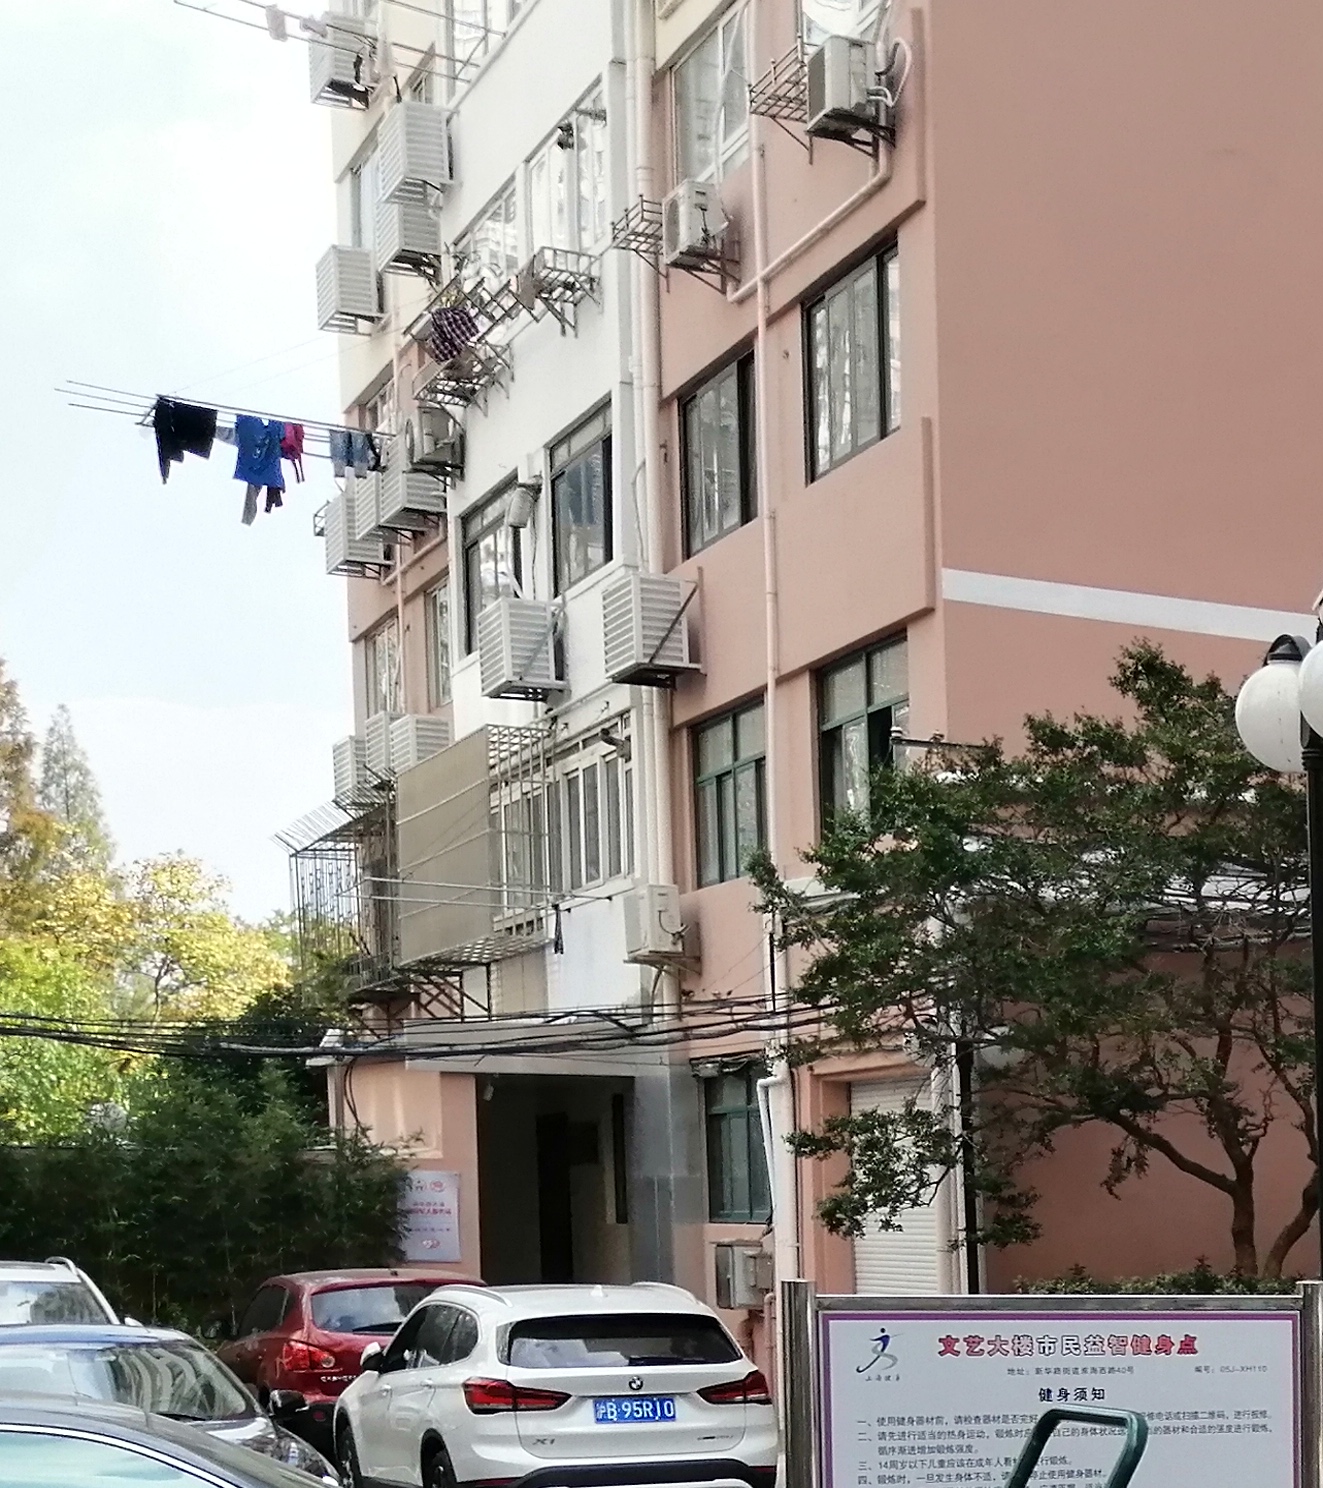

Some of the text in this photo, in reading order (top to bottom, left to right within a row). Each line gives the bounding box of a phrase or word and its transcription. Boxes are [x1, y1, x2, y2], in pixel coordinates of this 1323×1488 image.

[938, 1334, 1199, 1357] 文艺大楼市民益智健身点
[1038, 1387, 1106, 1402] 健身须知
